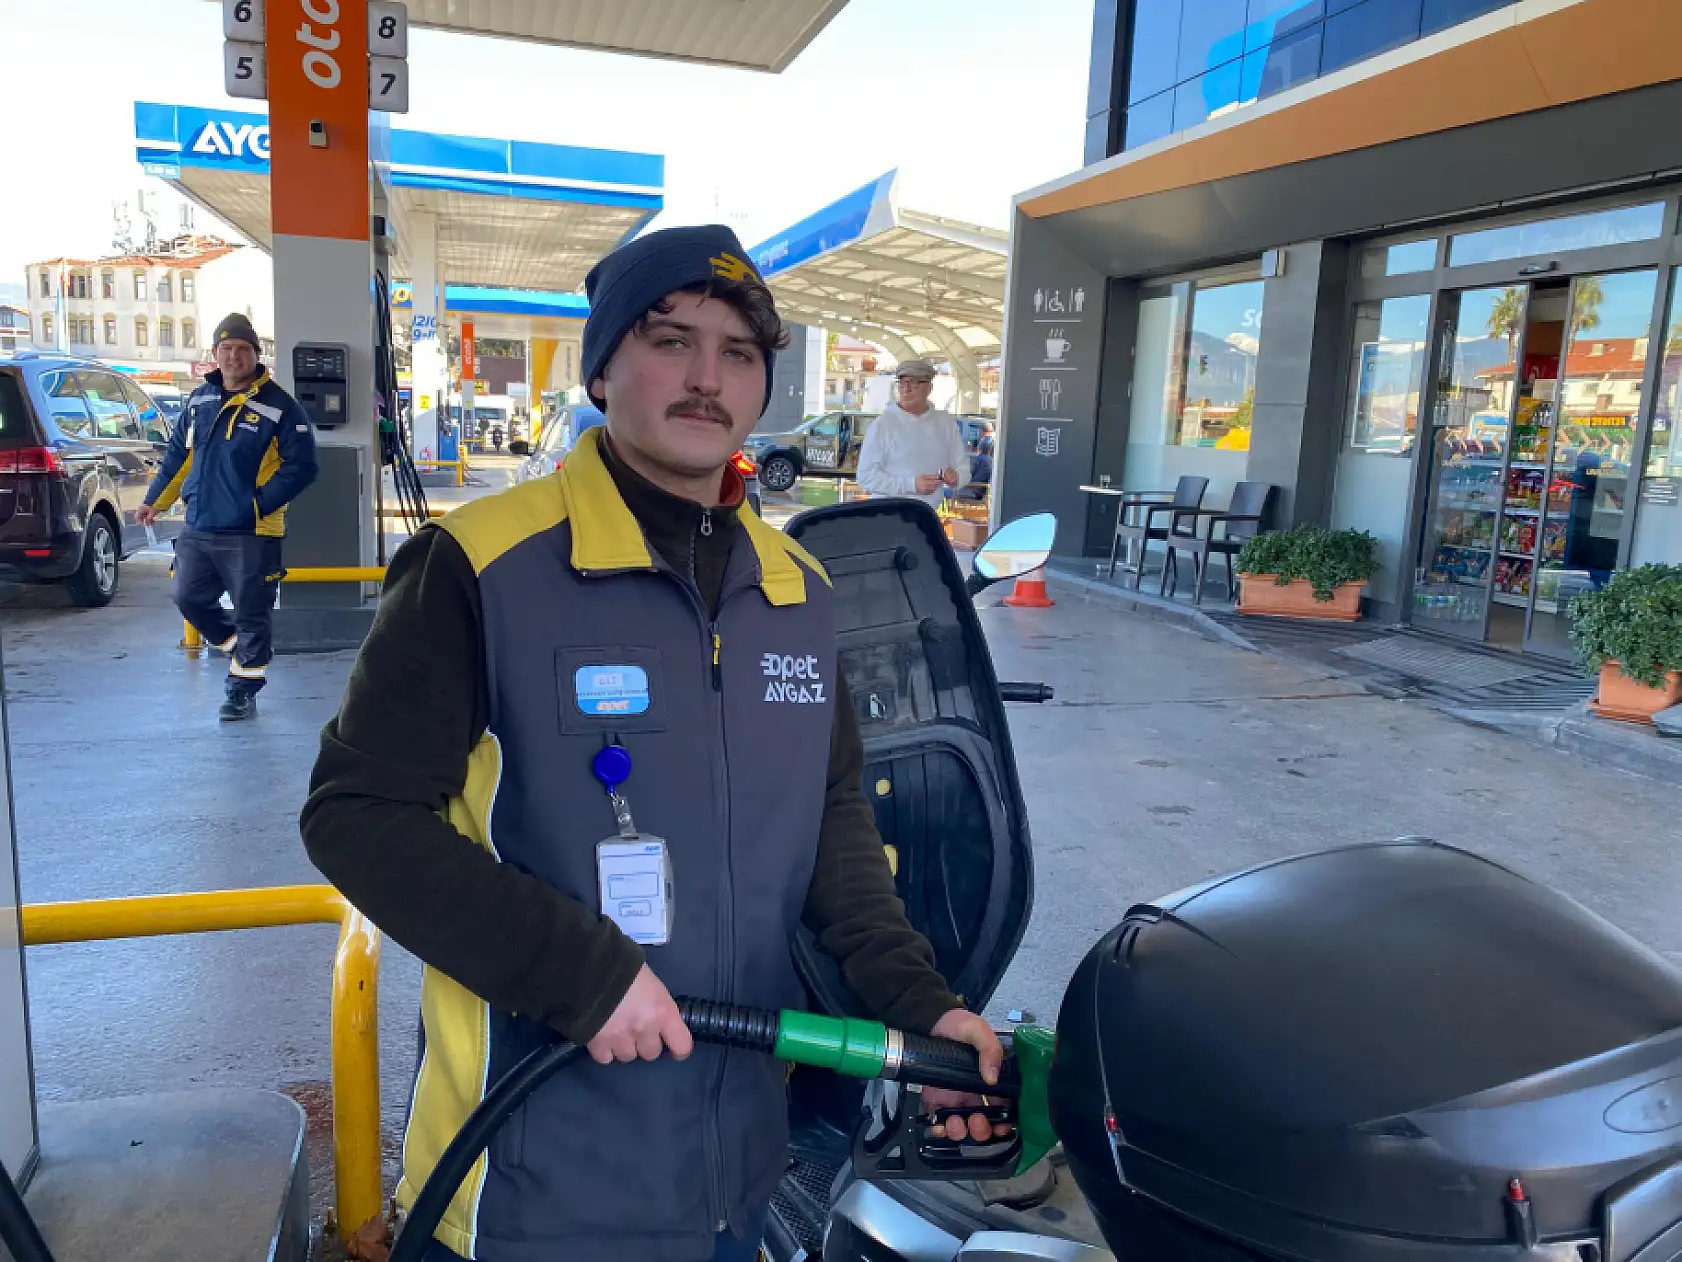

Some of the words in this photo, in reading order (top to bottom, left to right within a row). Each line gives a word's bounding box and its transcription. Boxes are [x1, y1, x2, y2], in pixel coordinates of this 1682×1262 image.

[234, 0, 252, 22] 6
[379, 16, 397, 39] 8
[234, 56, 253, 80] 5
[380, 73, 397, 96] 7
[192, 120, 271, 159] AYG
[764, 680, 827, 703] AYGAZ
